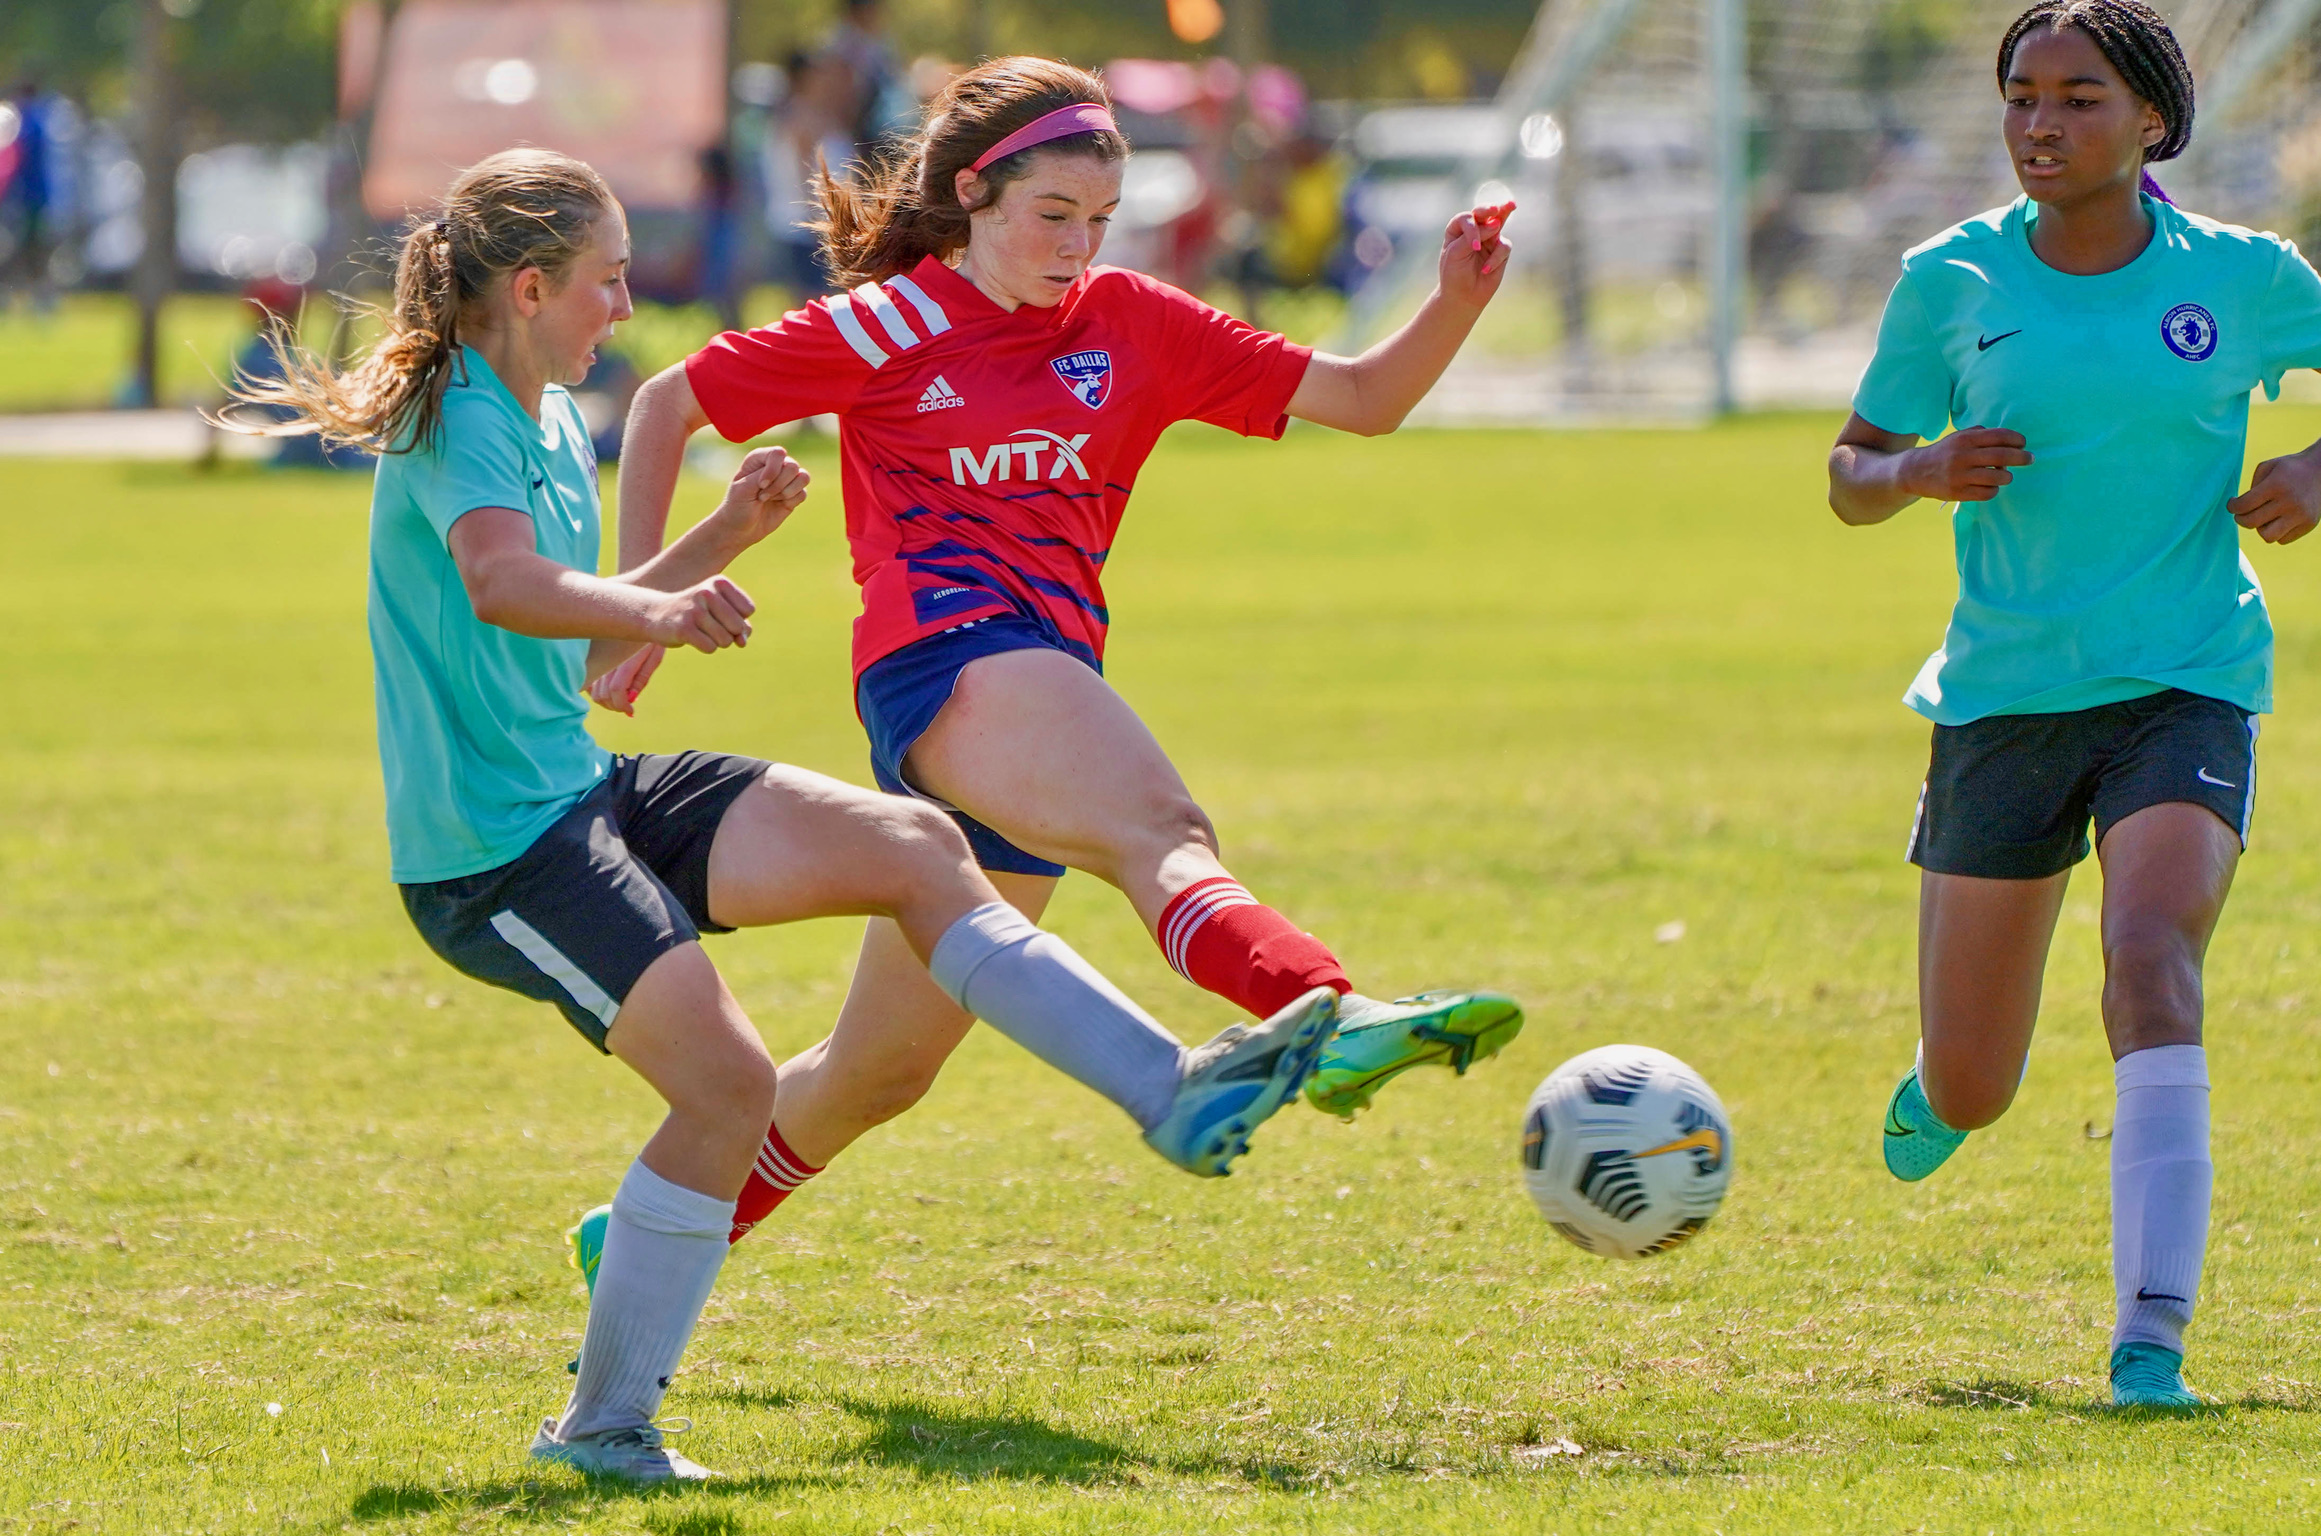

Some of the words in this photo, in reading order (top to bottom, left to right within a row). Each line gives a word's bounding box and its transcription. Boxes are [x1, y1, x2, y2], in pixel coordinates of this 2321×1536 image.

[2163, 310, 2176, 330] ALBION
[2176, 305, 2212, 322] HURRICANES
[2210, 322, 2216, 331] FC
[1056, 360, 1071, 372] FC
[1071, 353, 1107, 368] DALLAS
[917, 397, 965, 412] adidas
[949, 429, 1092, 486] MTX
